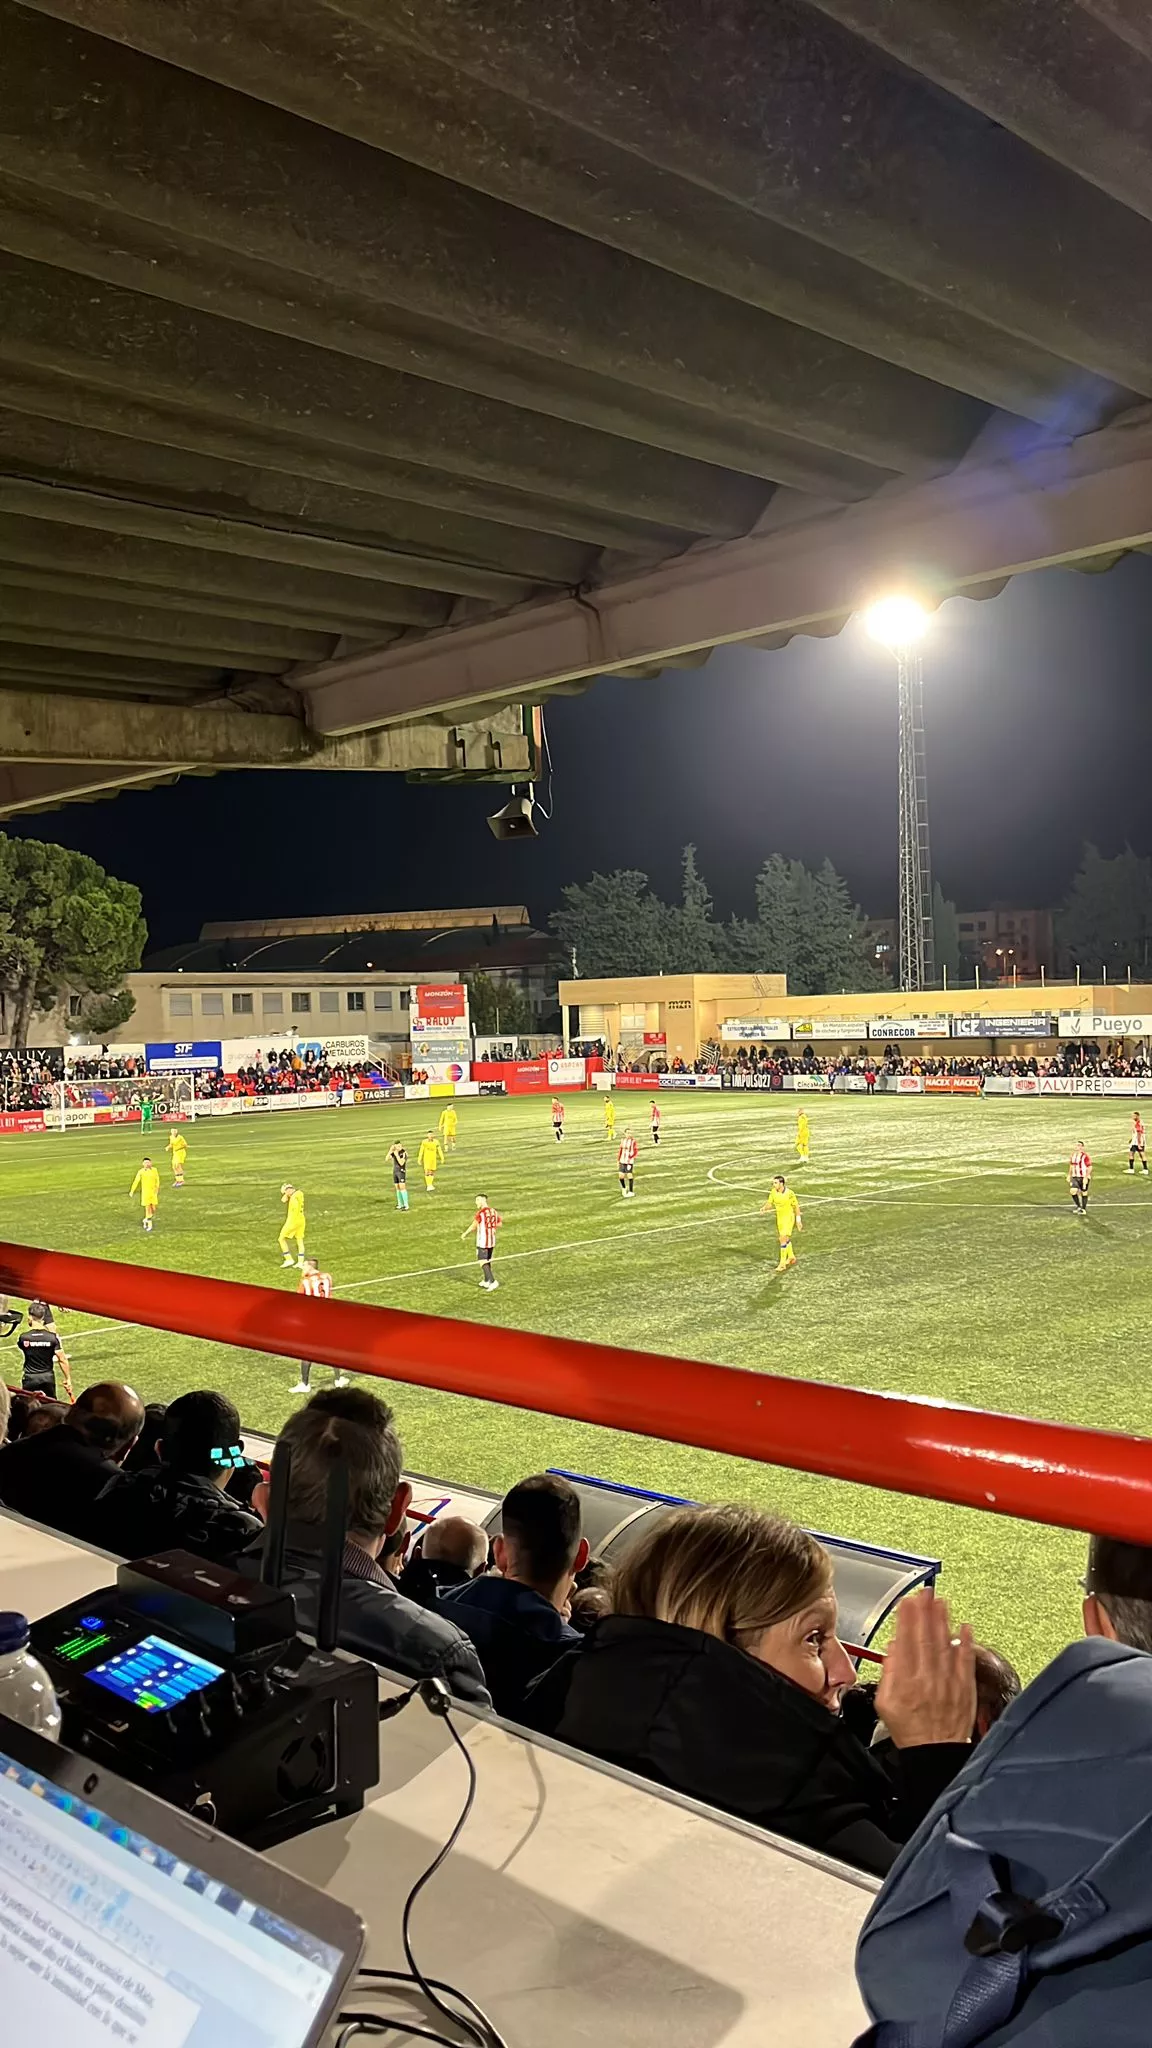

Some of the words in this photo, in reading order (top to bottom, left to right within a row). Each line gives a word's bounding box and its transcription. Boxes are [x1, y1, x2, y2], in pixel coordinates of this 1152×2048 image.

[426, 1016, 456, 1026] RALUY
[1093, 1017, 1142, 1034] Pueyo
[872, 1028, 916, 1037] CONRECOR
[174, 1043, 193, 1053] STF
[325, 1040, 365, 1048] CARBUROS
[0, 1050, 51, 1061] ALUY,
[925, 1078, 950, 1086] NACEX
[953, 1078, 979, 1086] NACEX
[364, 1090, 390, 1099] TAGSE
